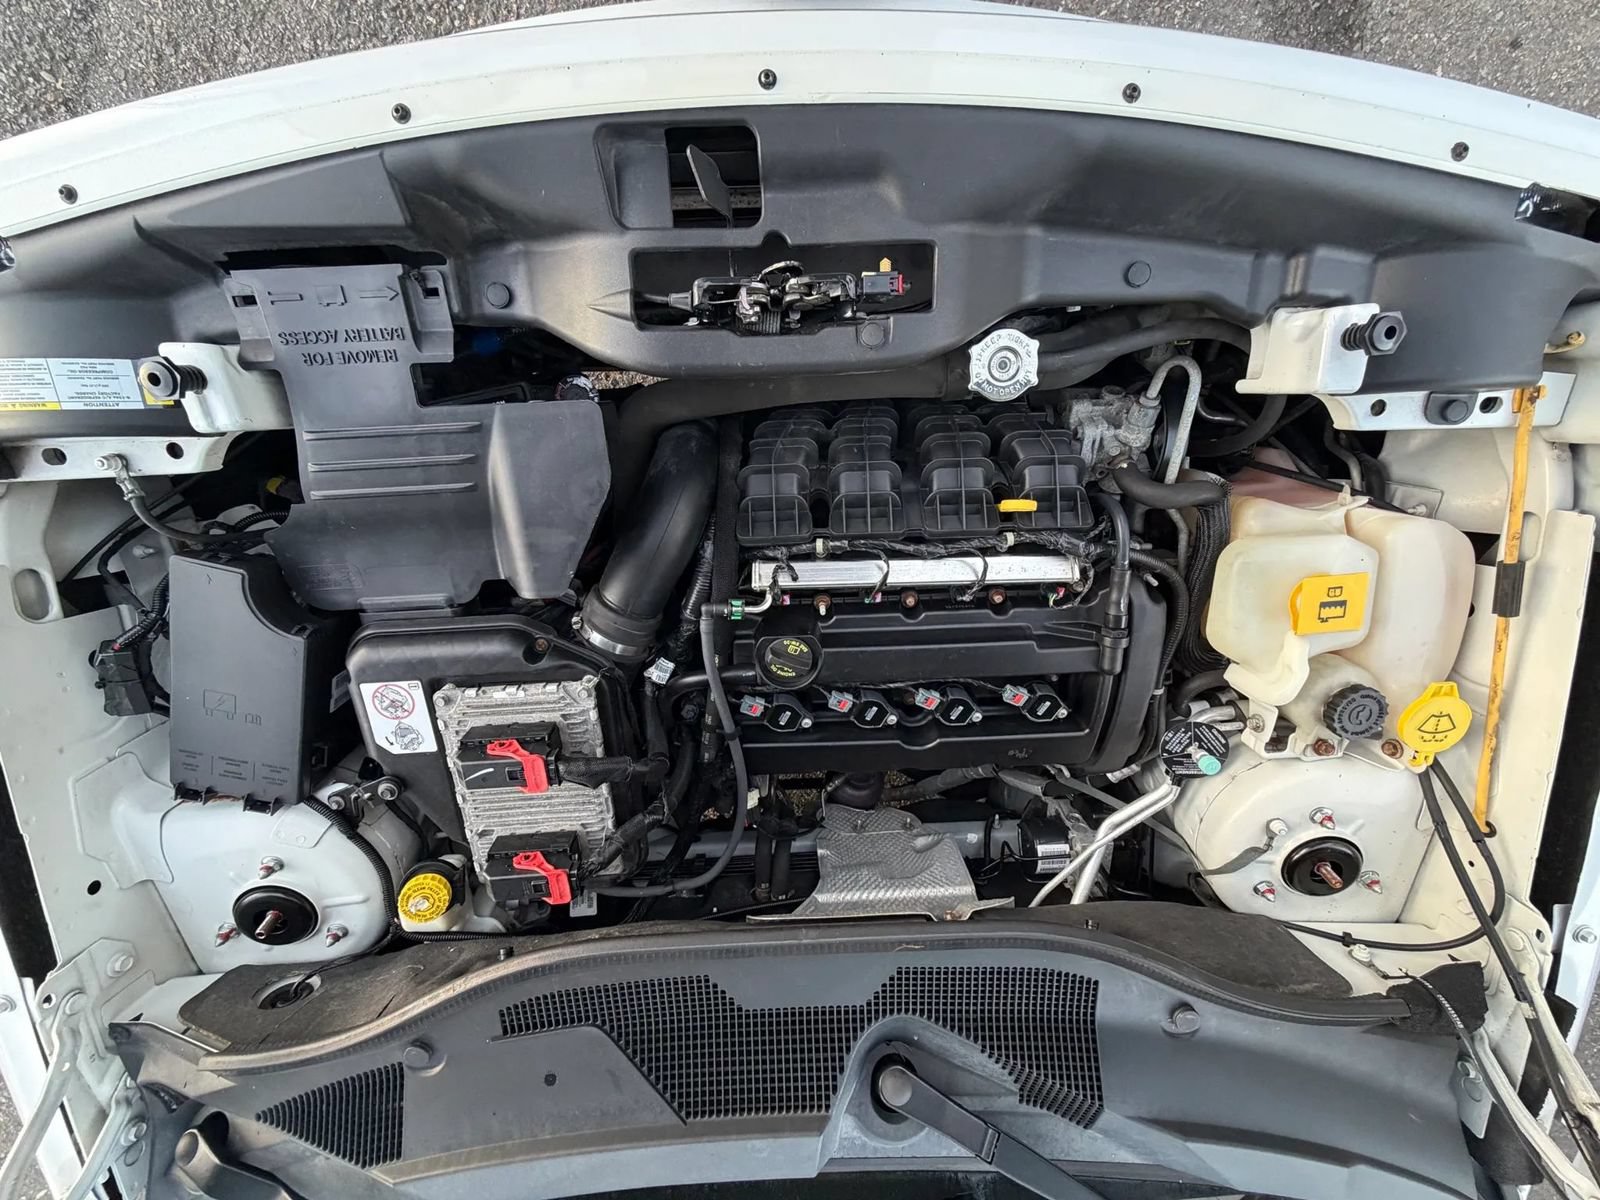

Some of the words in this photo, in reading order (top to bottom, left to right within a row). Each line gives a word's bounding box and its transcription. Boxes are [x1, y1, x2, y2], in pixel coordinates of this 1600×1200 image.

[277, 328, 339, 345] ACCESS
[344, 326, 406, 344] BATTERY
[301, 350, 334, 366] FOR
[336, 348, 399, 365] REMOVE
